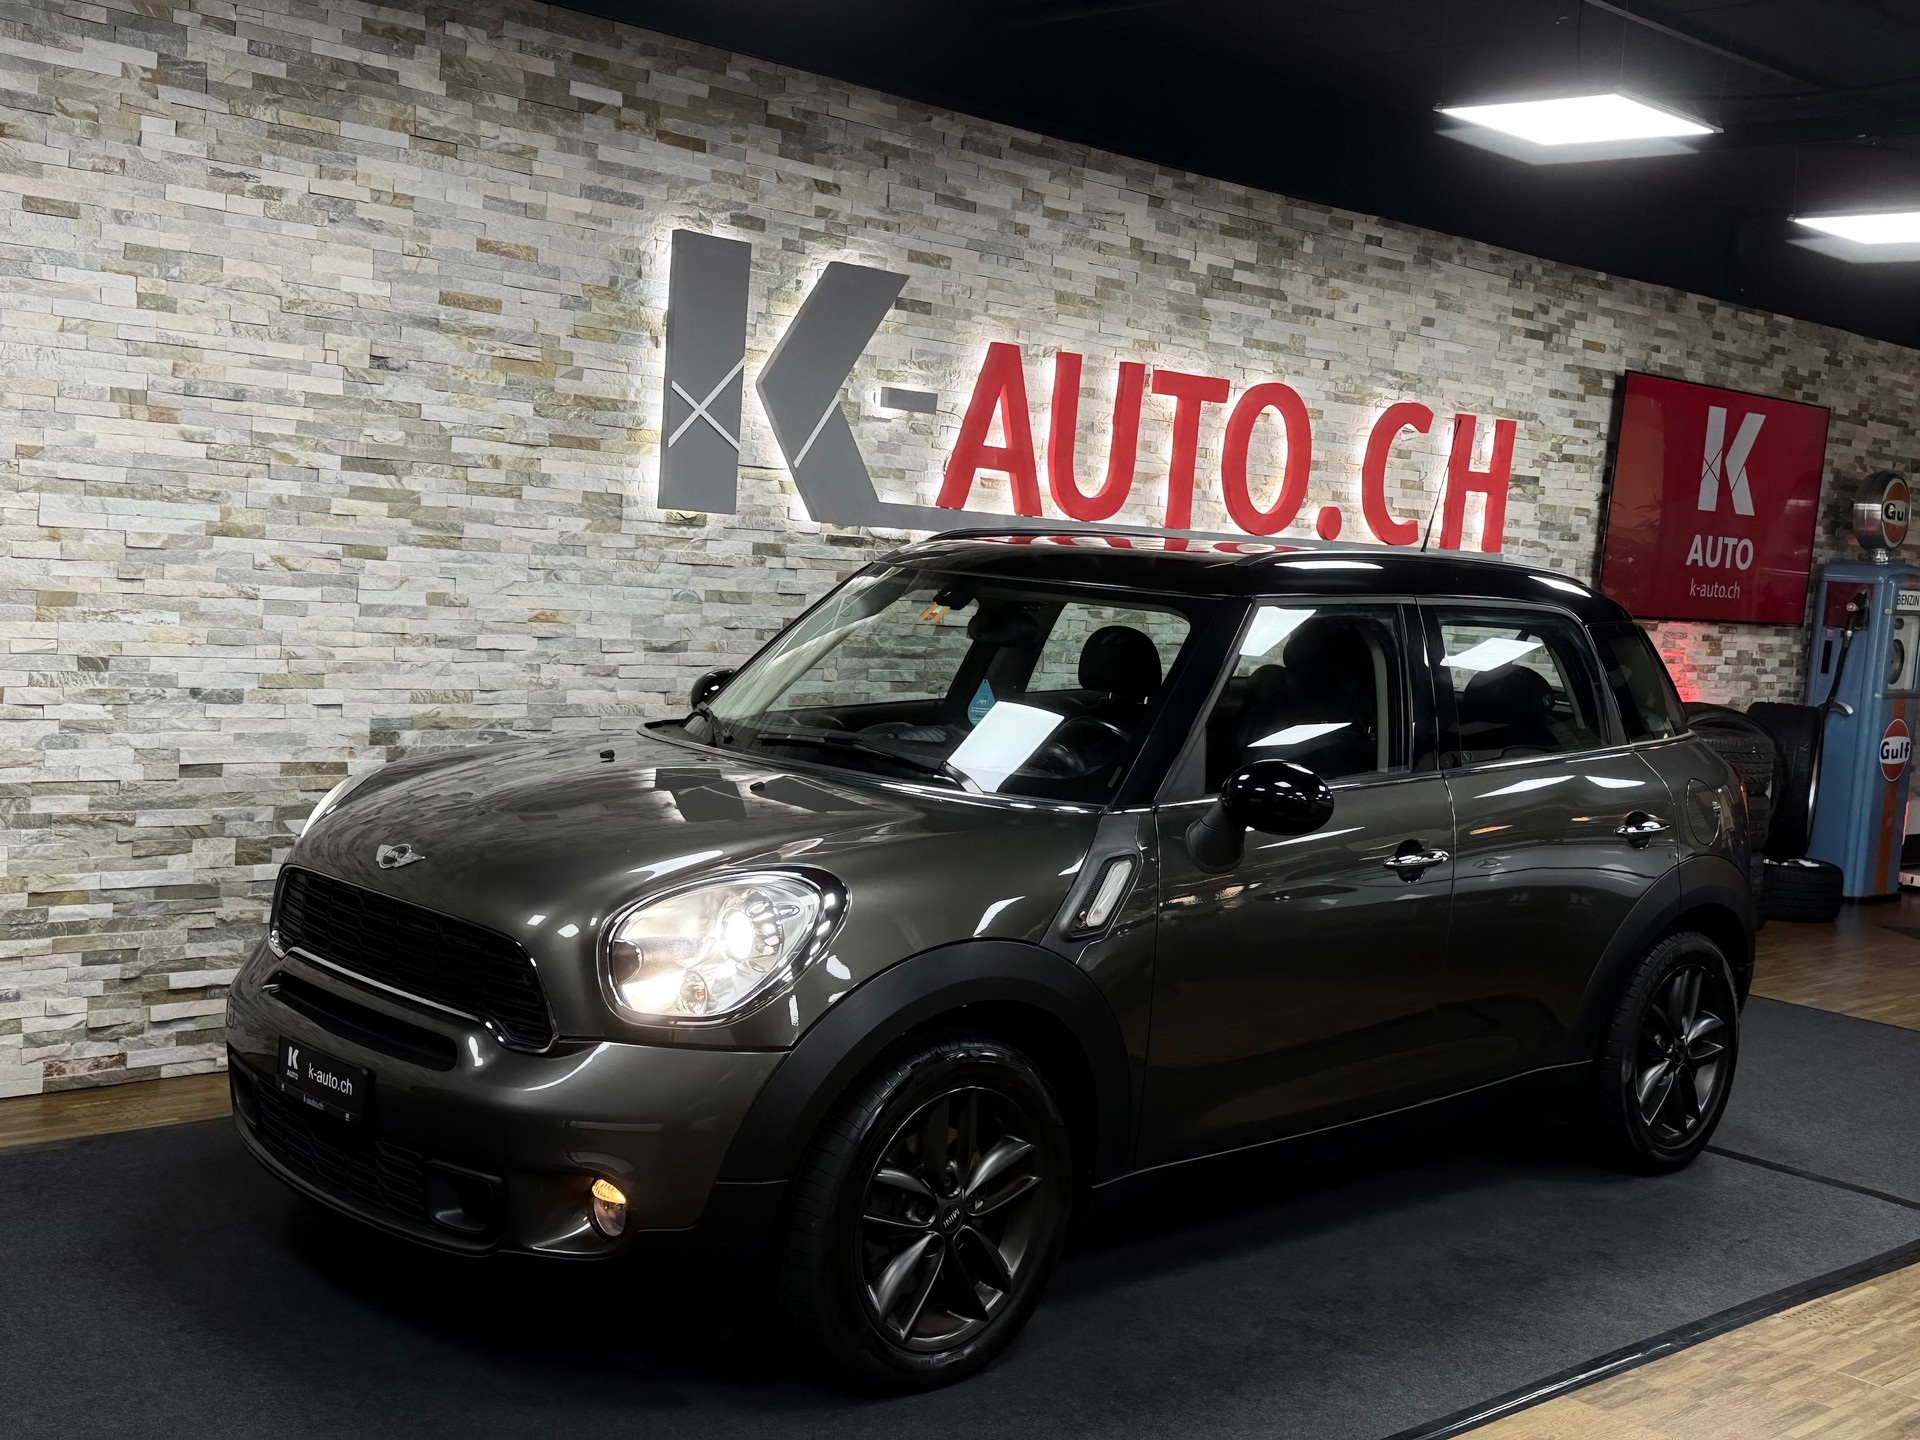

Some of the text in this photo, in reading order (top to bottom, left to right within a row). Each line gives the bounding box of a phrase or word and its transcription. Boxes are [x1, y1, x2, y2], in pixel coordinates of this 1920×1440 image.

[1697, 405, 1767, 517] K
[1884, 502, 1908, 521] Gul
[1685, 534, 1754, 570] AUTO
[1689, 578, 1740, 599] k-auto.ch
[1880, 741, 1910, 760] Gulf
[308, 1062, 353, 1095] k-auto.ch
